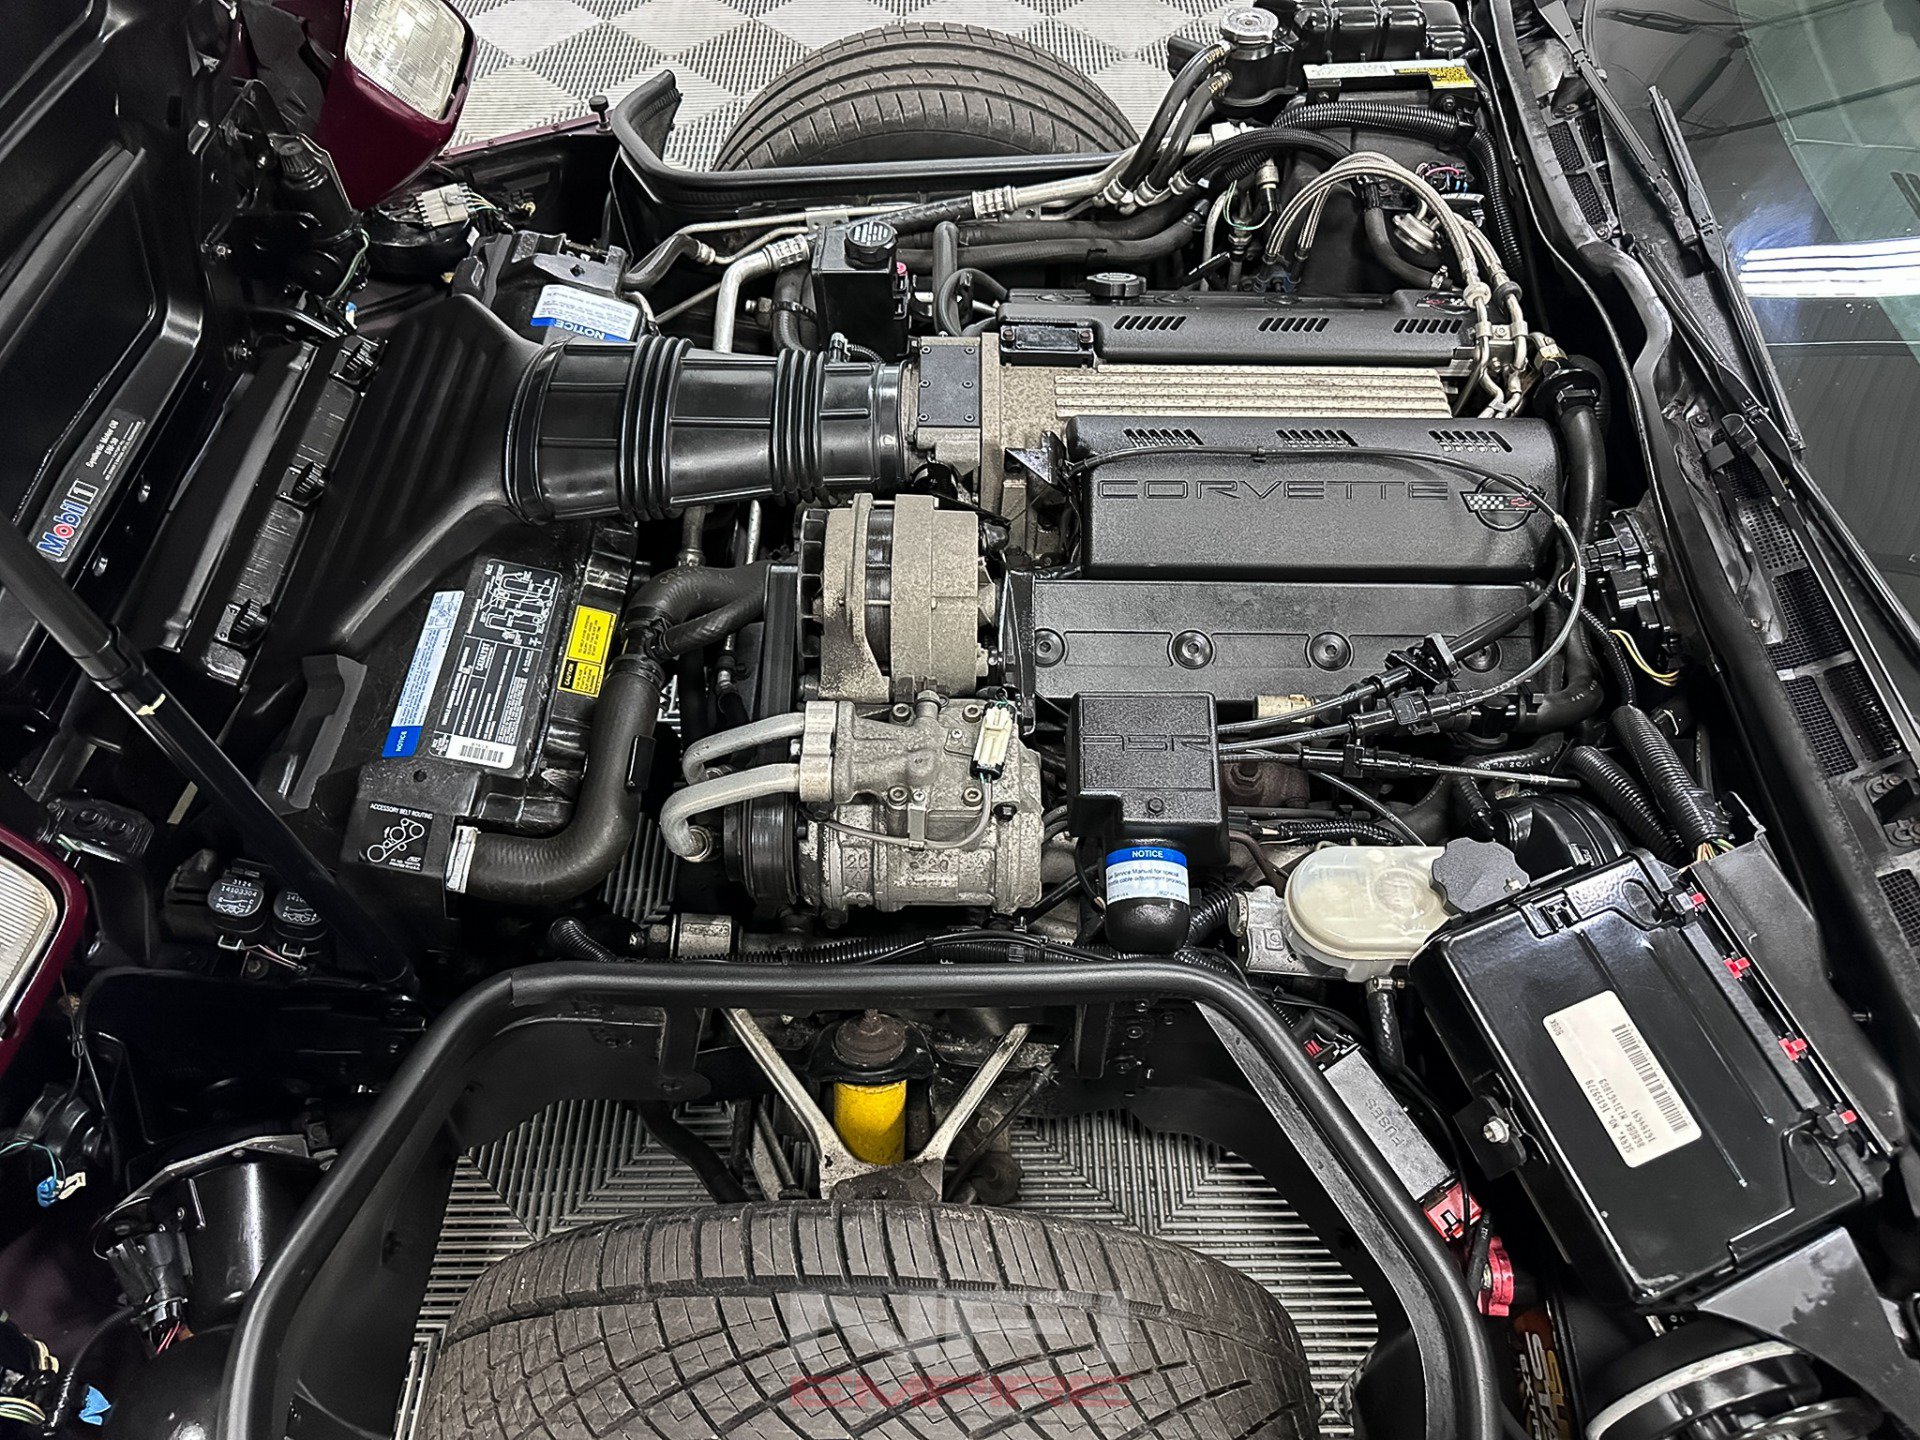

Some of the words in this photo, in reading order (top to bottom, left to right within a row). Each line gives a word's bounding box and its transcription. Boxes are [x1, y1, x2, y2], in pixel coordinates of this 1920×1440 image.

[554, 319, 605, 340] NOTICE
[1098, 480, 1449, 501] CORVETTE
[36, 498, 88, 557] Mobil
[475, 643, 491, 671] CATALYST
[564, 662, 575, 686] CAUTION
[396, 730, 407, 753] NOTICE
[370, 803, 398, 813] ACCESSORY
[411, 810, 433, 819] ROUTING
[1132, 850, 1164, 858] NOTICE
[233, 879, 252, 887] 3124
[1364, 1097, 1405, 1148] FUSES
